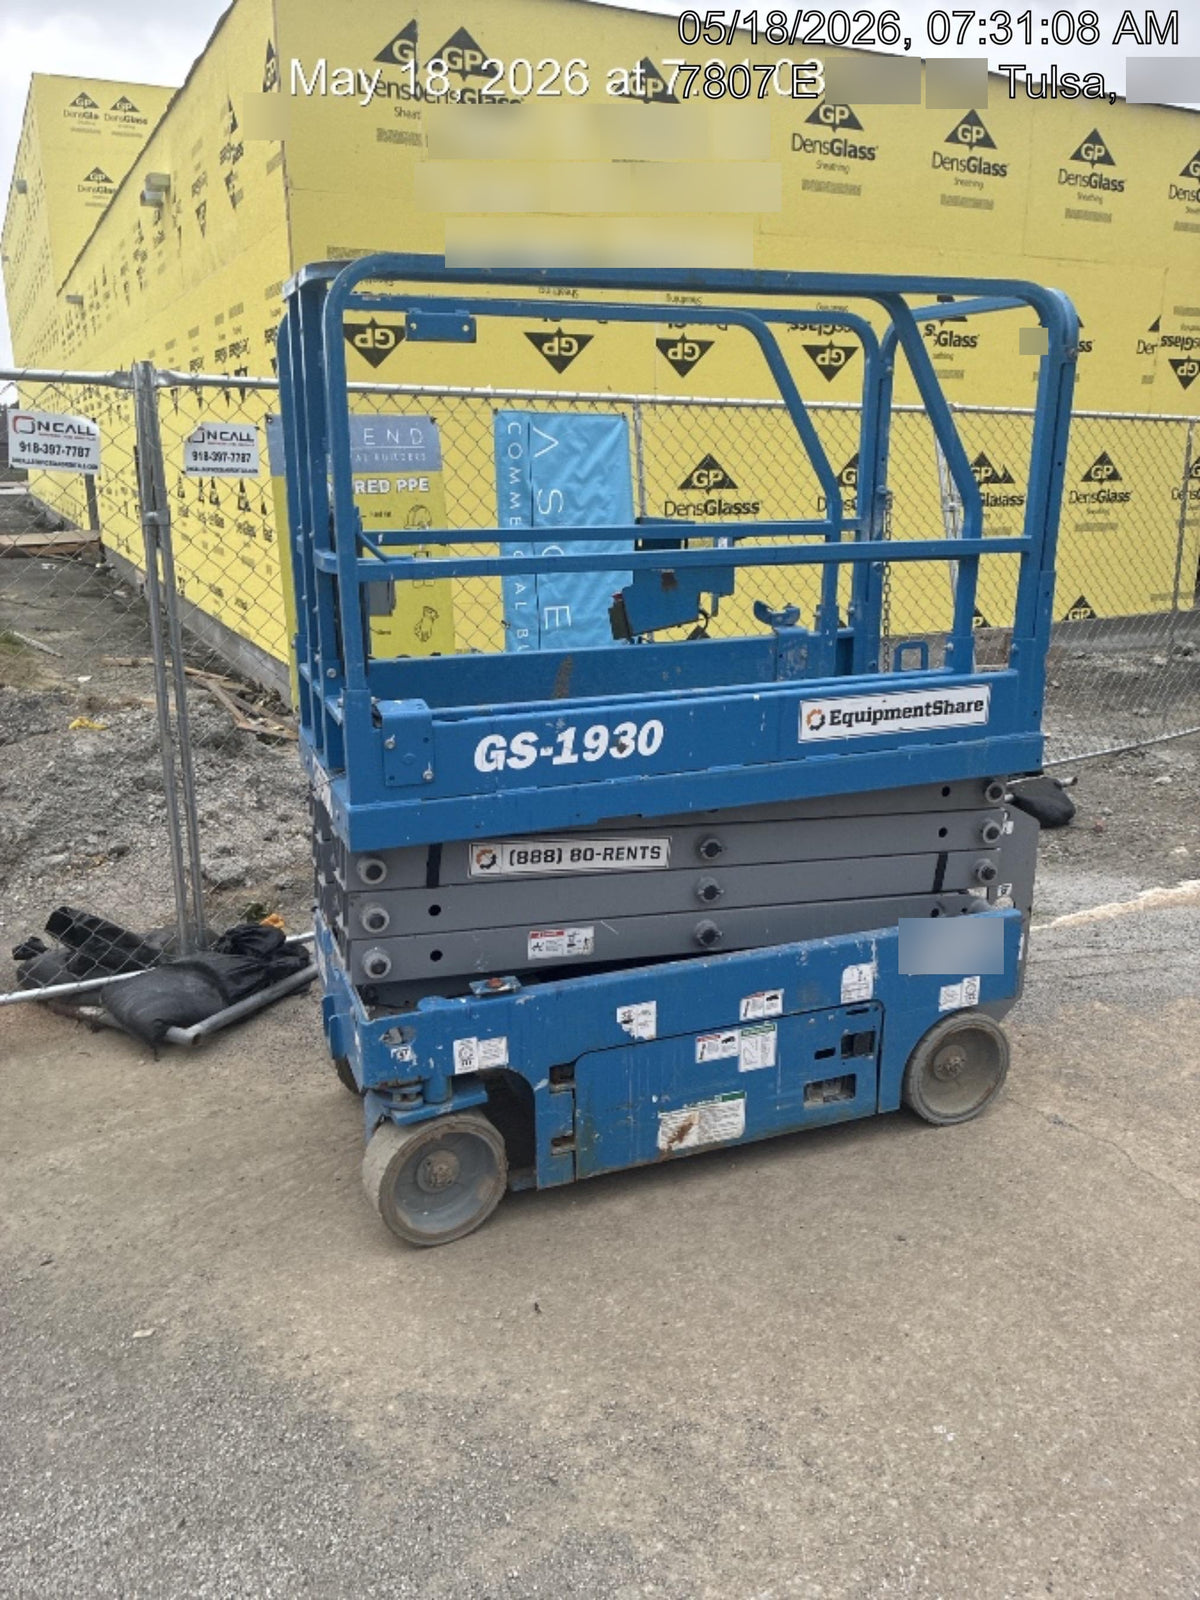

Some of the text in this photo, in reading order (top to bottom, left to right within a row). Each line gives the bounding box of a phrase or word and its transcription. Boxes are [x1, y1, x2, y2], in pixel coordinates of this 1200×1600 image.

[442, 47, 483, 72] GP
[819, 104, 850, 125] GP
[957, 123, 985, 143] GP
[791, 133, 877, 161] DensGlass
[1080, 143, 1106, 161] GP
[932, 151, 1008, 177] DensGlass
[1057, 168, 1125, 193] DensGlass
[353, 327, 396, 350] GP
[541, 336, 579, 357] GP
[667, 341, 701, 361] GP
[815, 347, 846, 366] GP
[1177, 361, 1200, 377] GP
[19, 440, 91, 458] 918-397-7787
[191, 450, 251, 463] 918-397-7787
[692, 469, 725, 487] GP
[1090, 464, 1114, 480] GP
[396, 477, 430, 494] PPE
[1068, 490, 1133, 506] DensGlass
[829, 699, 985, 728] EquipmentShare
[474, 719, 665, 773] GS-1930
[509, 845, 662, 867] (888) 80-RENTS
